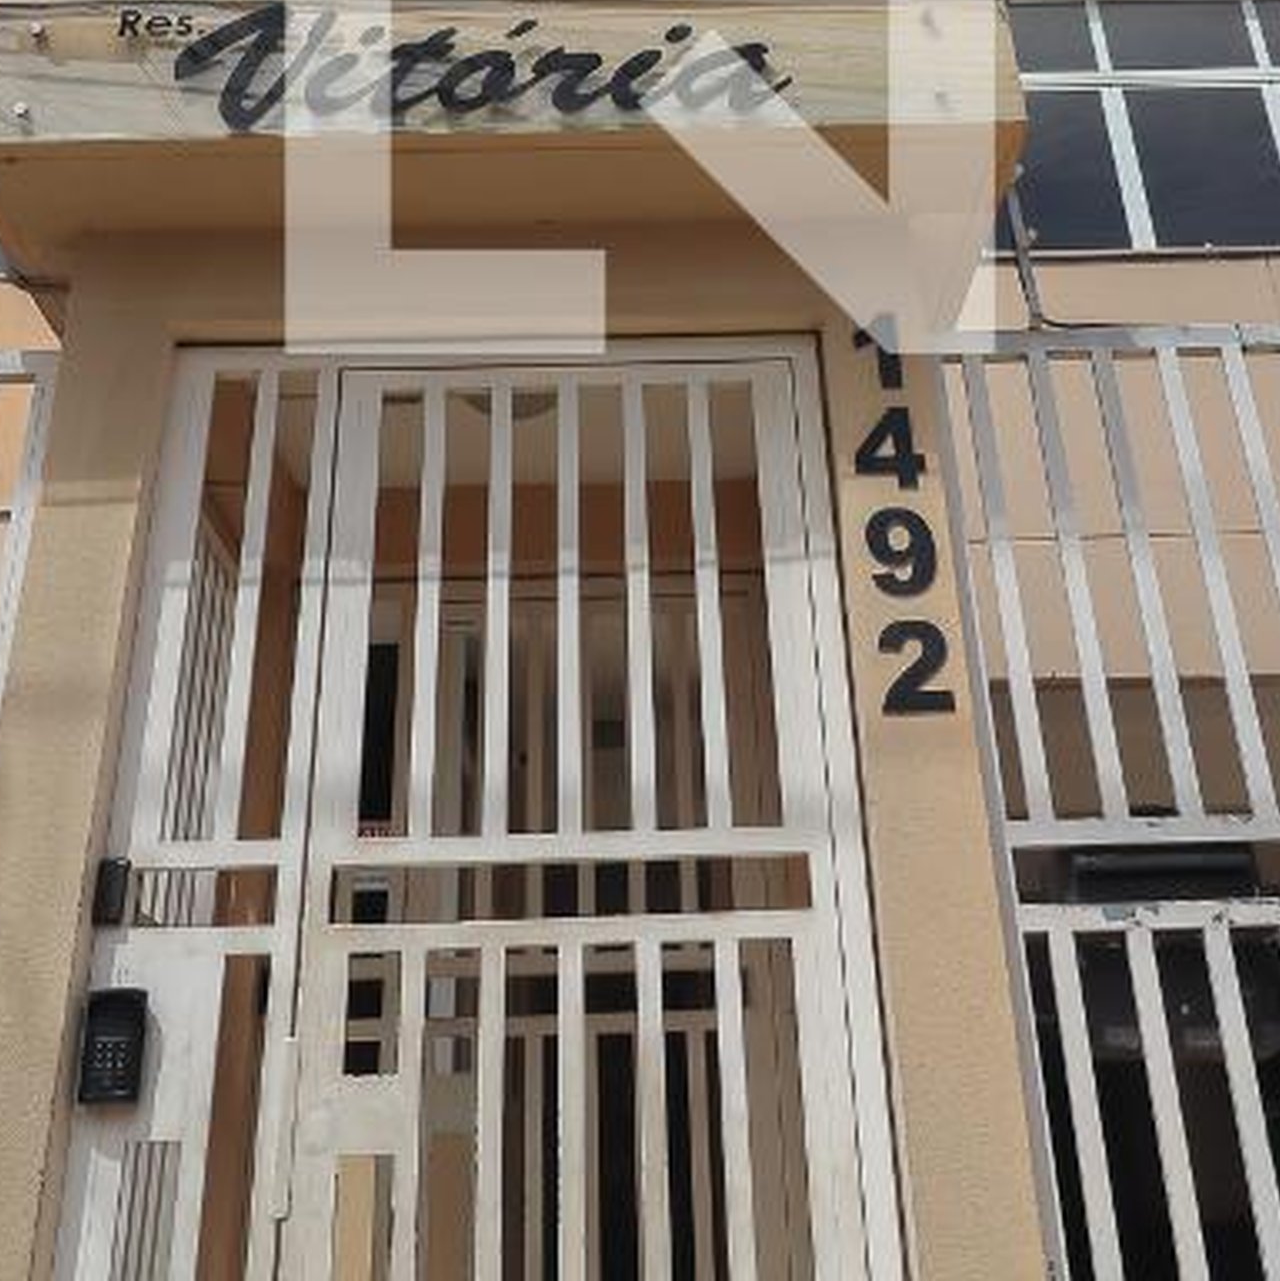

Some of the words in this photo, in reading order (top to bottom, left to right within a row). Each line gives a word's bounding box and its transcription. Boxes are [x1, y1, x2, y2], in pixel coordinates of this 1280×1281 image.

[118, 8, 207, 39] Res.
[174, 3, 793, 131] Vitória
[853, 312, 957, 715] 1492
